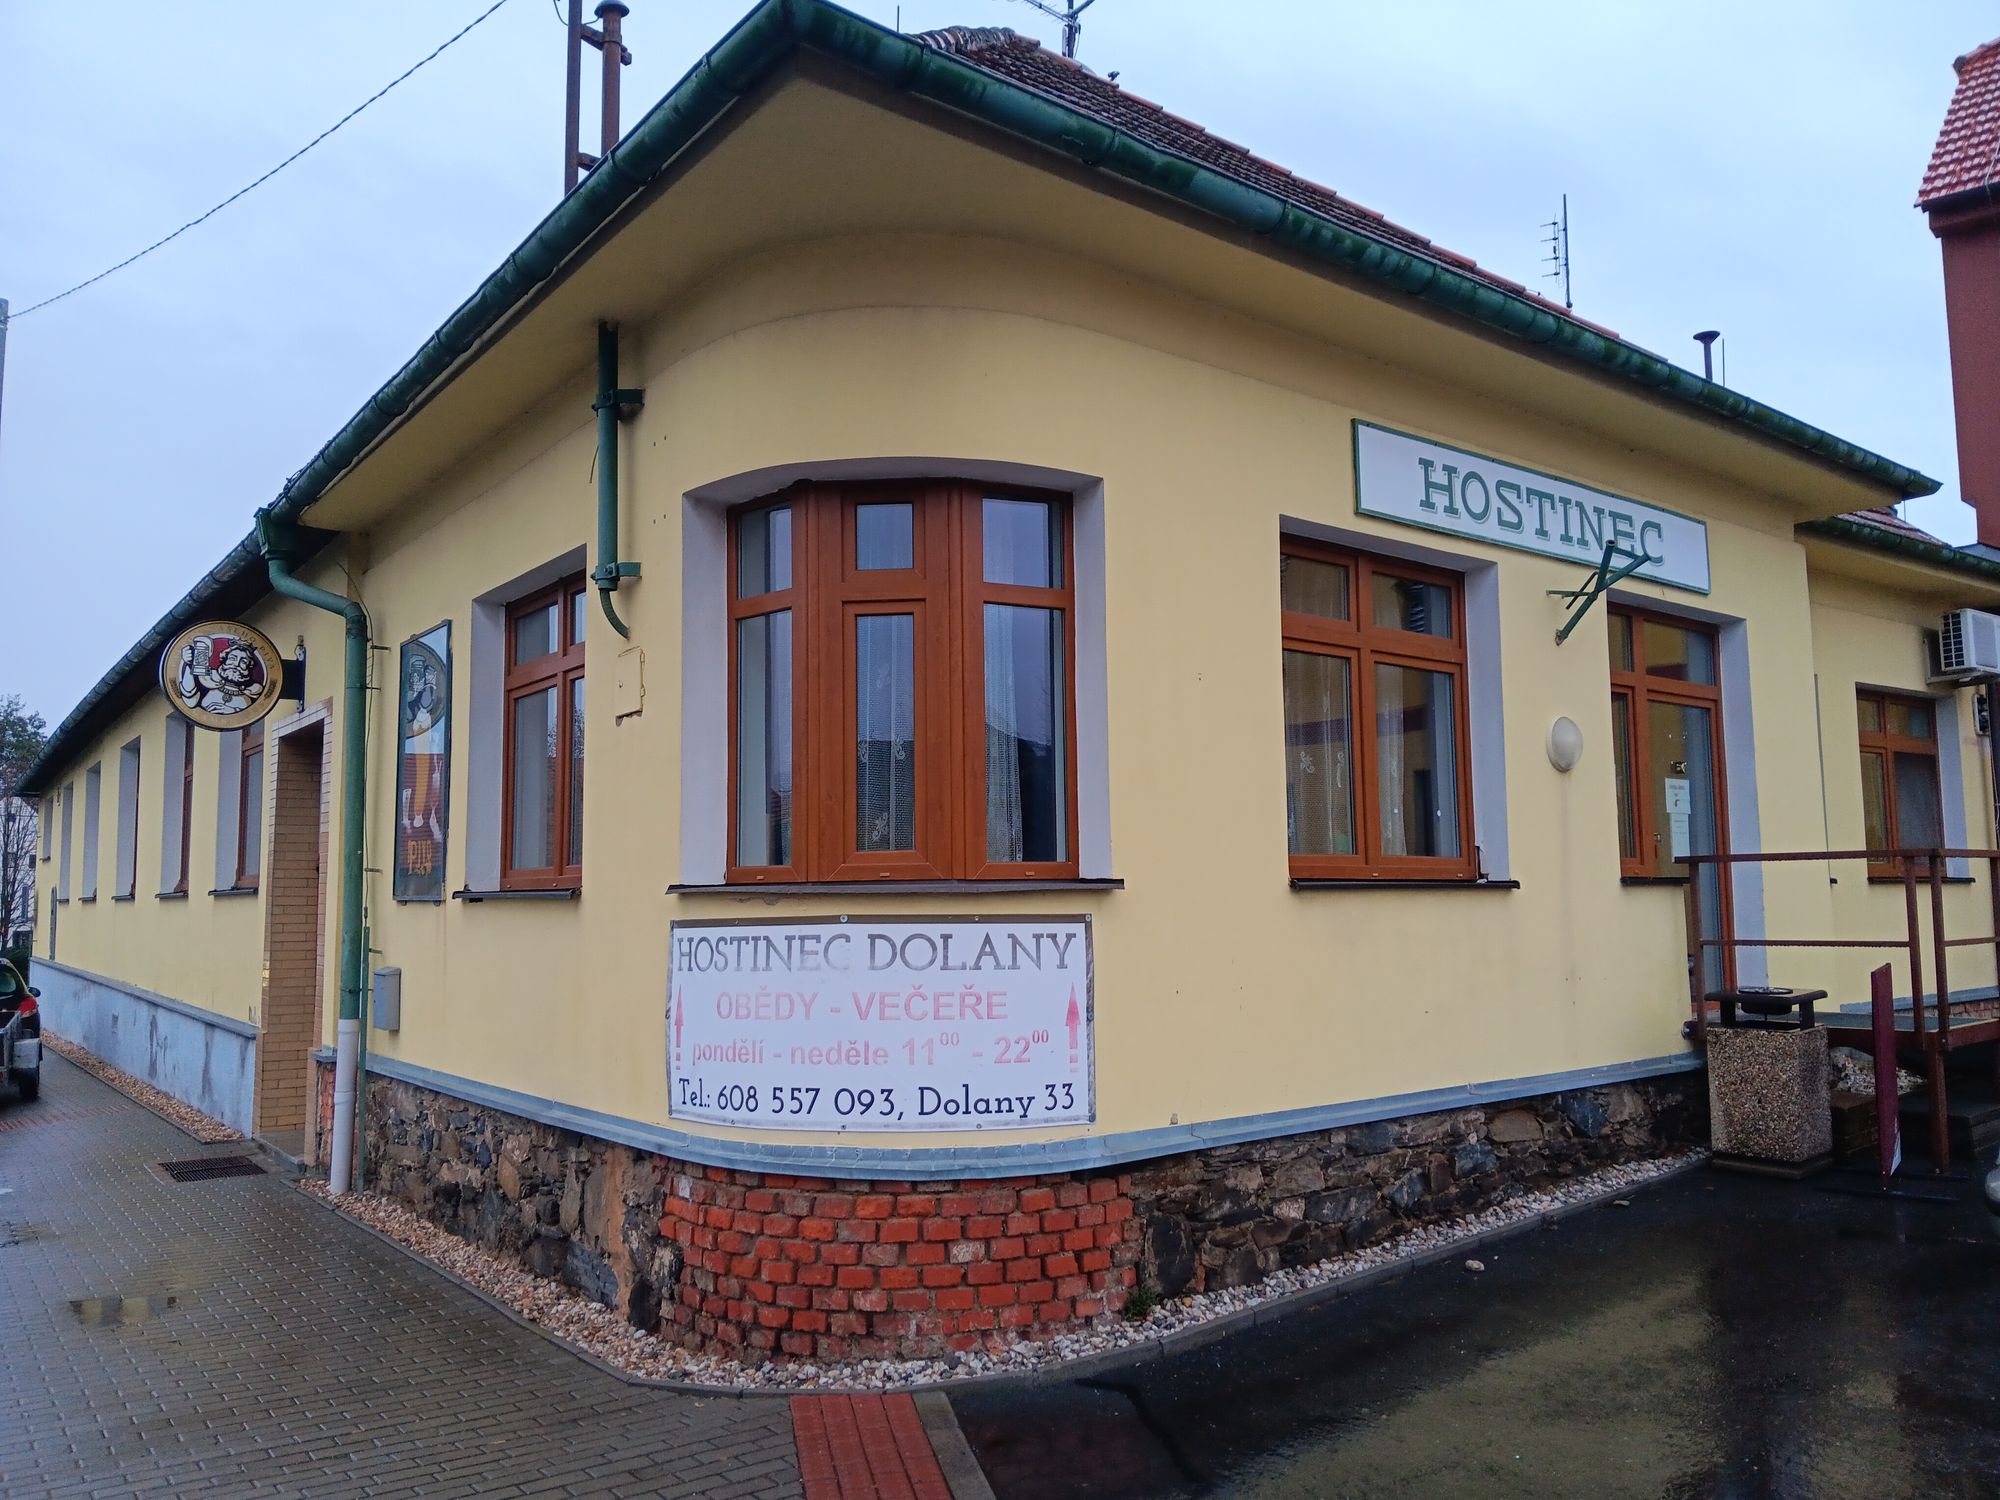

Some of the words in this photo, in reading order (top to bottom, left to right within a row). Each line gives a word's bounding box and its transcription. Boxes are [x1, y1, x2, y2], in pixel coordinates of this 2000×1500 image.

[1418, 457, 1664, 565] HOSTINEC
[677, 933, 851, 973] HOSTINEC
[867, 932, 1077, 971] DOLANY
[716, 986, 819, 1021] OBĚDY
[851, 984, 1009, 1021] VEČEŘE
[692, 1041, 764, 1066] pondělí
[790, 1039, 889, 1066] neděle
[678, 1078, 711, 1109] Tel.:
[717, 1084, 759, 1112] 608
[771, 1087, 820, 1116] 557
[833, 1087, 904, 1121] 093,
[918, 1084, 1035, 1119] Dolany
[1045, 1082, 1075, 1111] 33
